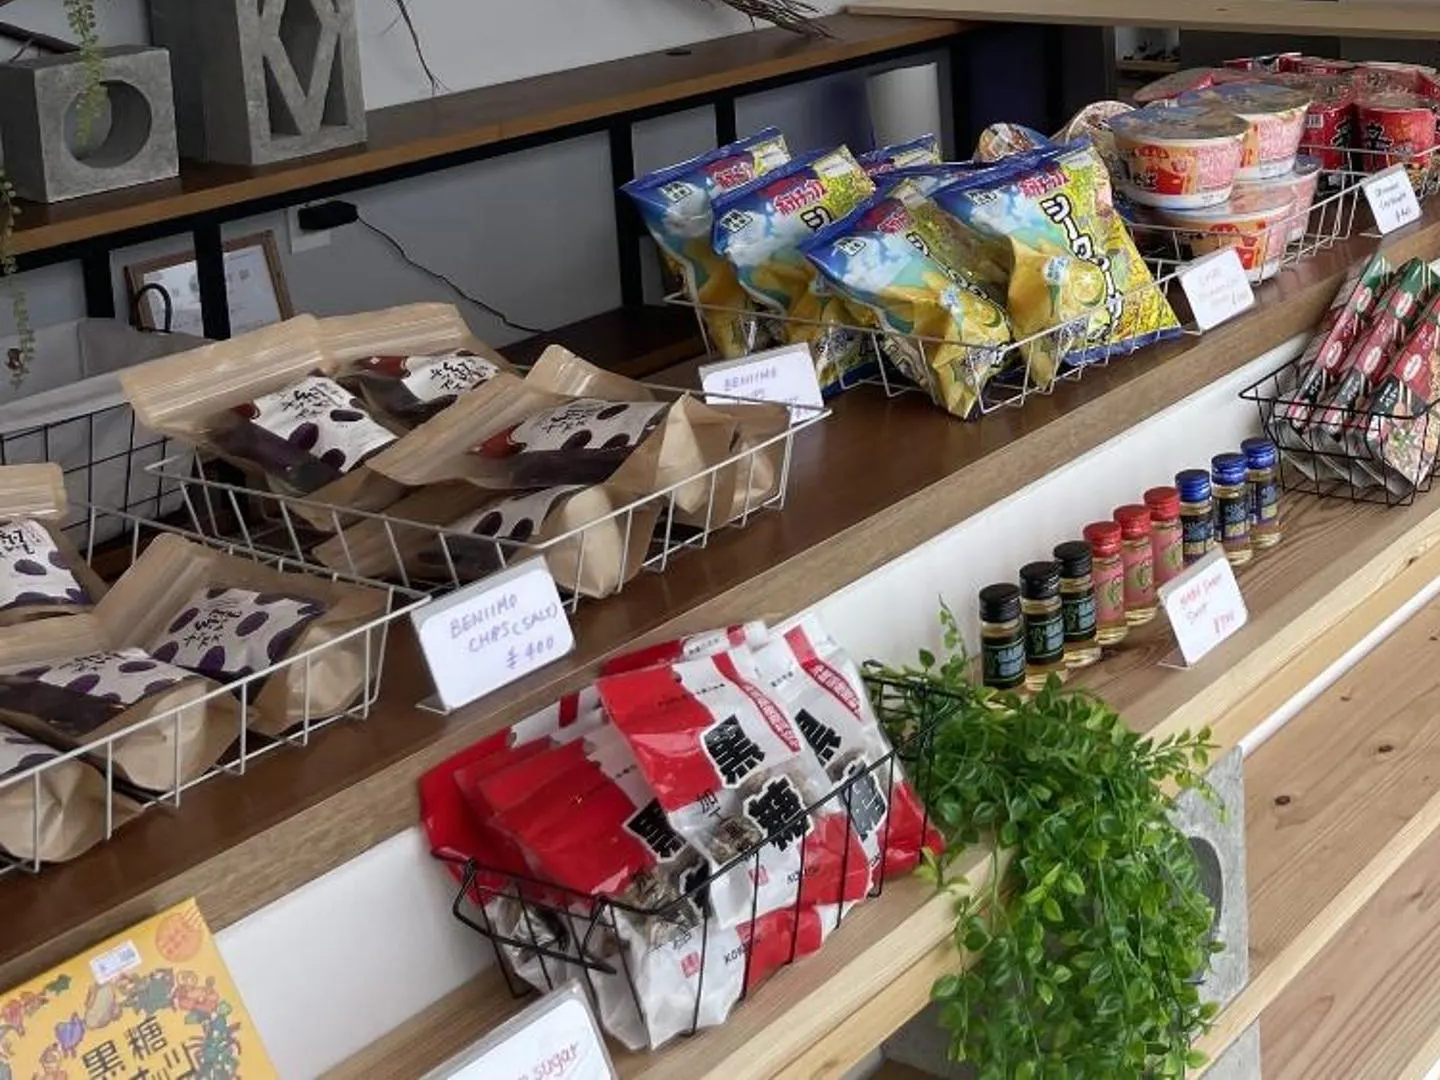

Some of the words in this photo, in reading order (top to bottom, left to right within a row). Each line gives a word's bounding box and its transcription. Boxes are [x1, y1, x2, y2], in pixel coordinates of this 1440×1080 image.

[451, 593, 518, 639] BENIIMO
[82, 1016, 168, 1080] 黒糖
[533, 1041, 578, 1079] sugar
